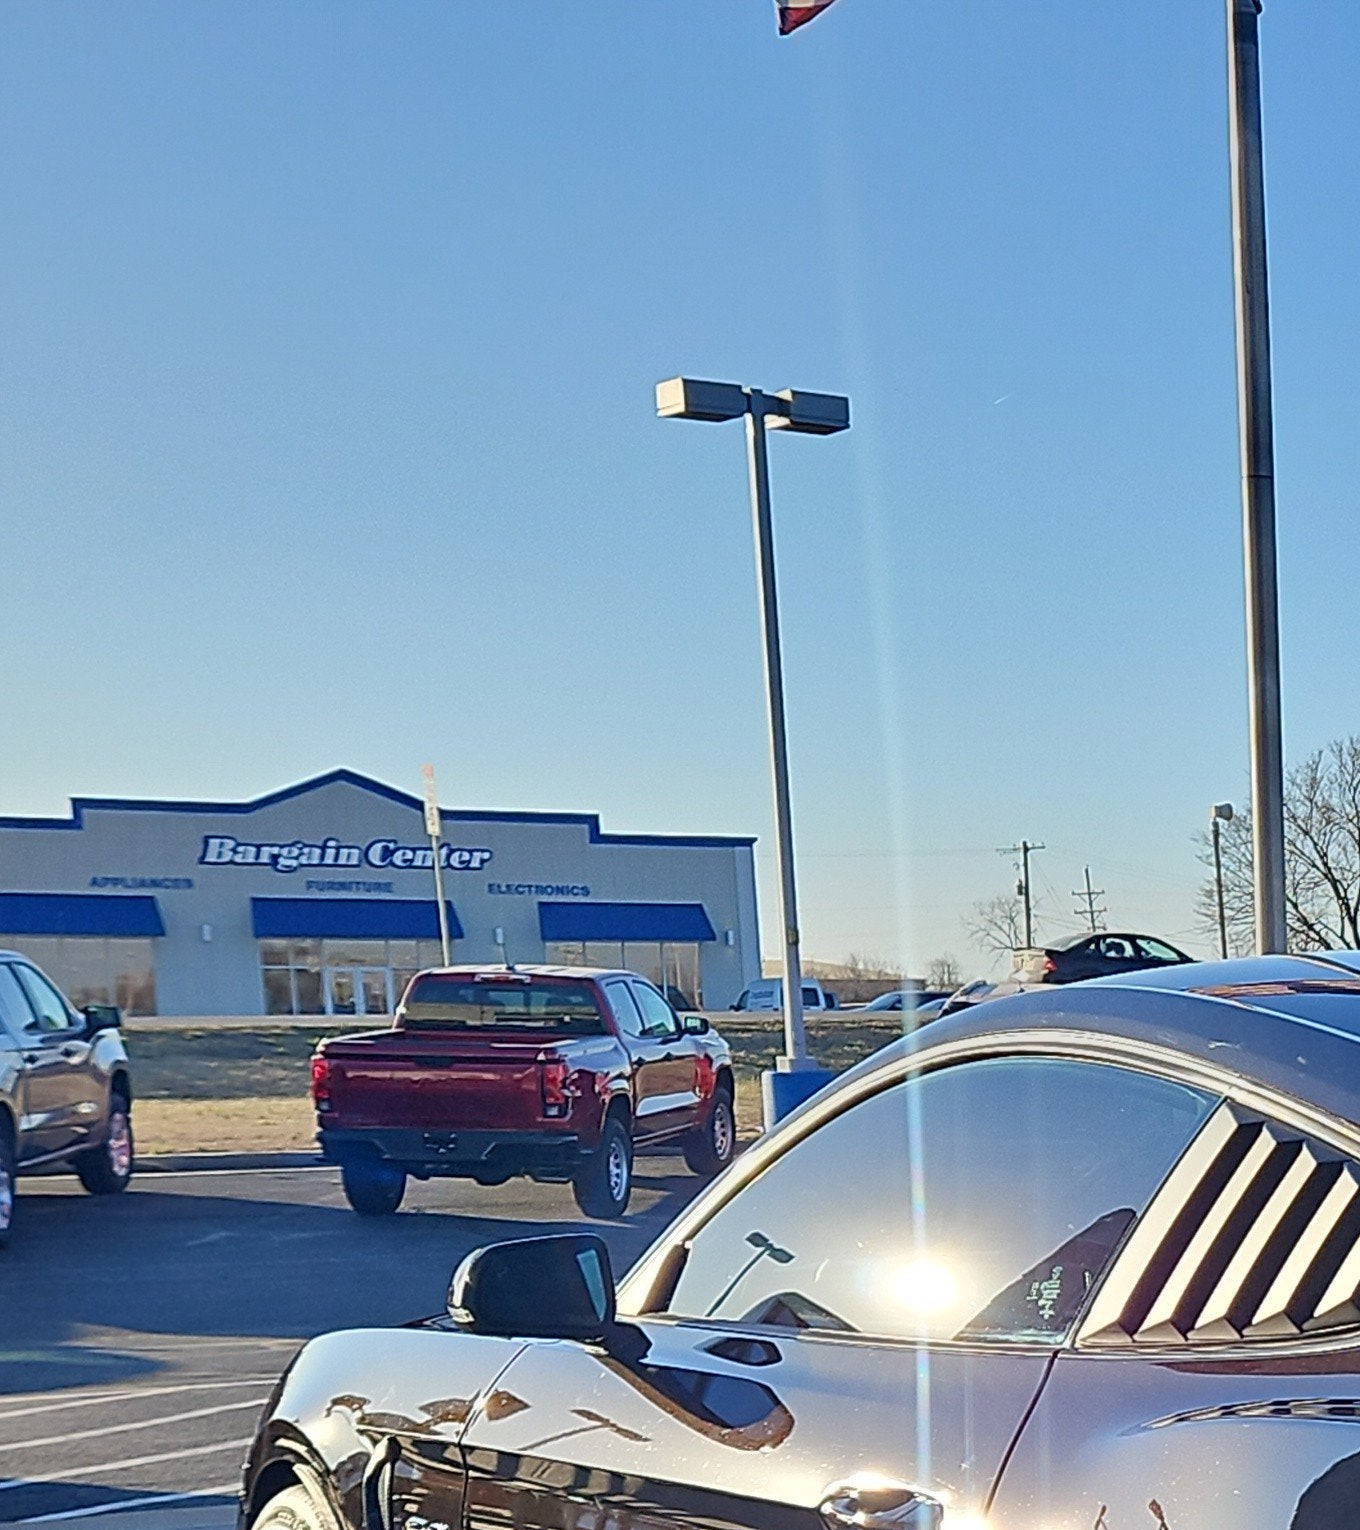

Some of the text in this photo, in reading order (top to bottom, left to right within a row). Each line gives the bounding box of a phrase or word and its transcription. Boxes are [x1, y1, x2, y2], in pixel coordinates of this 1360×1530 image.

[201, 836, 492, 872] Bargain Center
[306, 880, 393, 893] FURNITURE
[488, 883, 591, 896] ELECTRONICS
